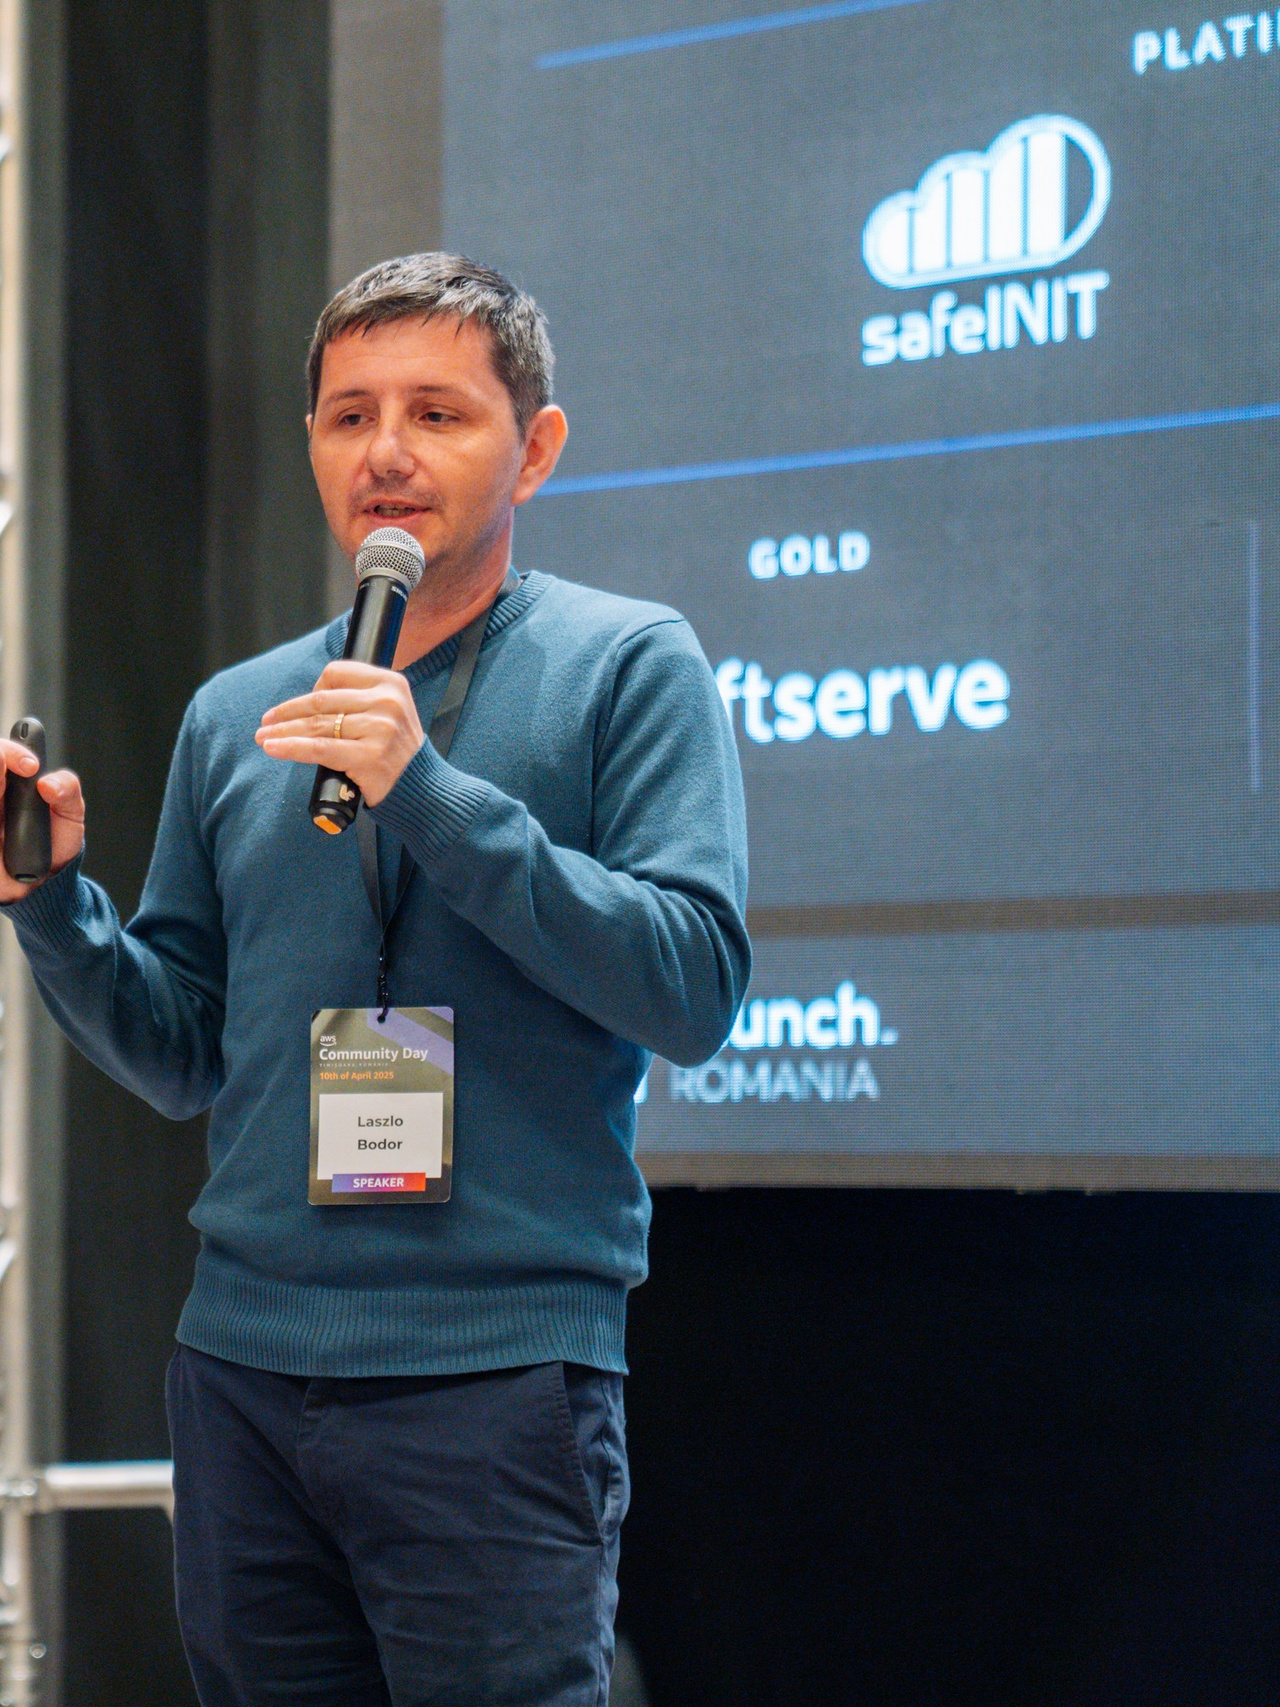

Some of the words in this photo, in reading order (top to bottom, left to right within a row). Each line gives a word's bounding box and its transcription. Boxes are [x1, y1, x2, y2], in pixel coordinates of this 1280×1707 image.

[1132, 7, 1280, 75] PLATI
[861, 269, 1110, 366] safeINIT
[748, 530, 870, 579] GOLD
[725, 979, 898, 1049] unch.
[320, 1035, 336, 1043] aws
[319, 1047, 398, 1062] Community
[402, 1047, 428, 1061] Day
[320, 1072, 338, 1080] 10th
[340, 1071, 350, 1080] of
[351, 1071, 372, 1081] April
[373, 1071, 394, 1080] 2025
[670, 1058, 880, 1102] ROMANIA
[357, 1115, 404, 1127] Laszlo
[357, 1139, 403, 1150] Bodor
[353, 1177, 405, 1189] SPEAKER
